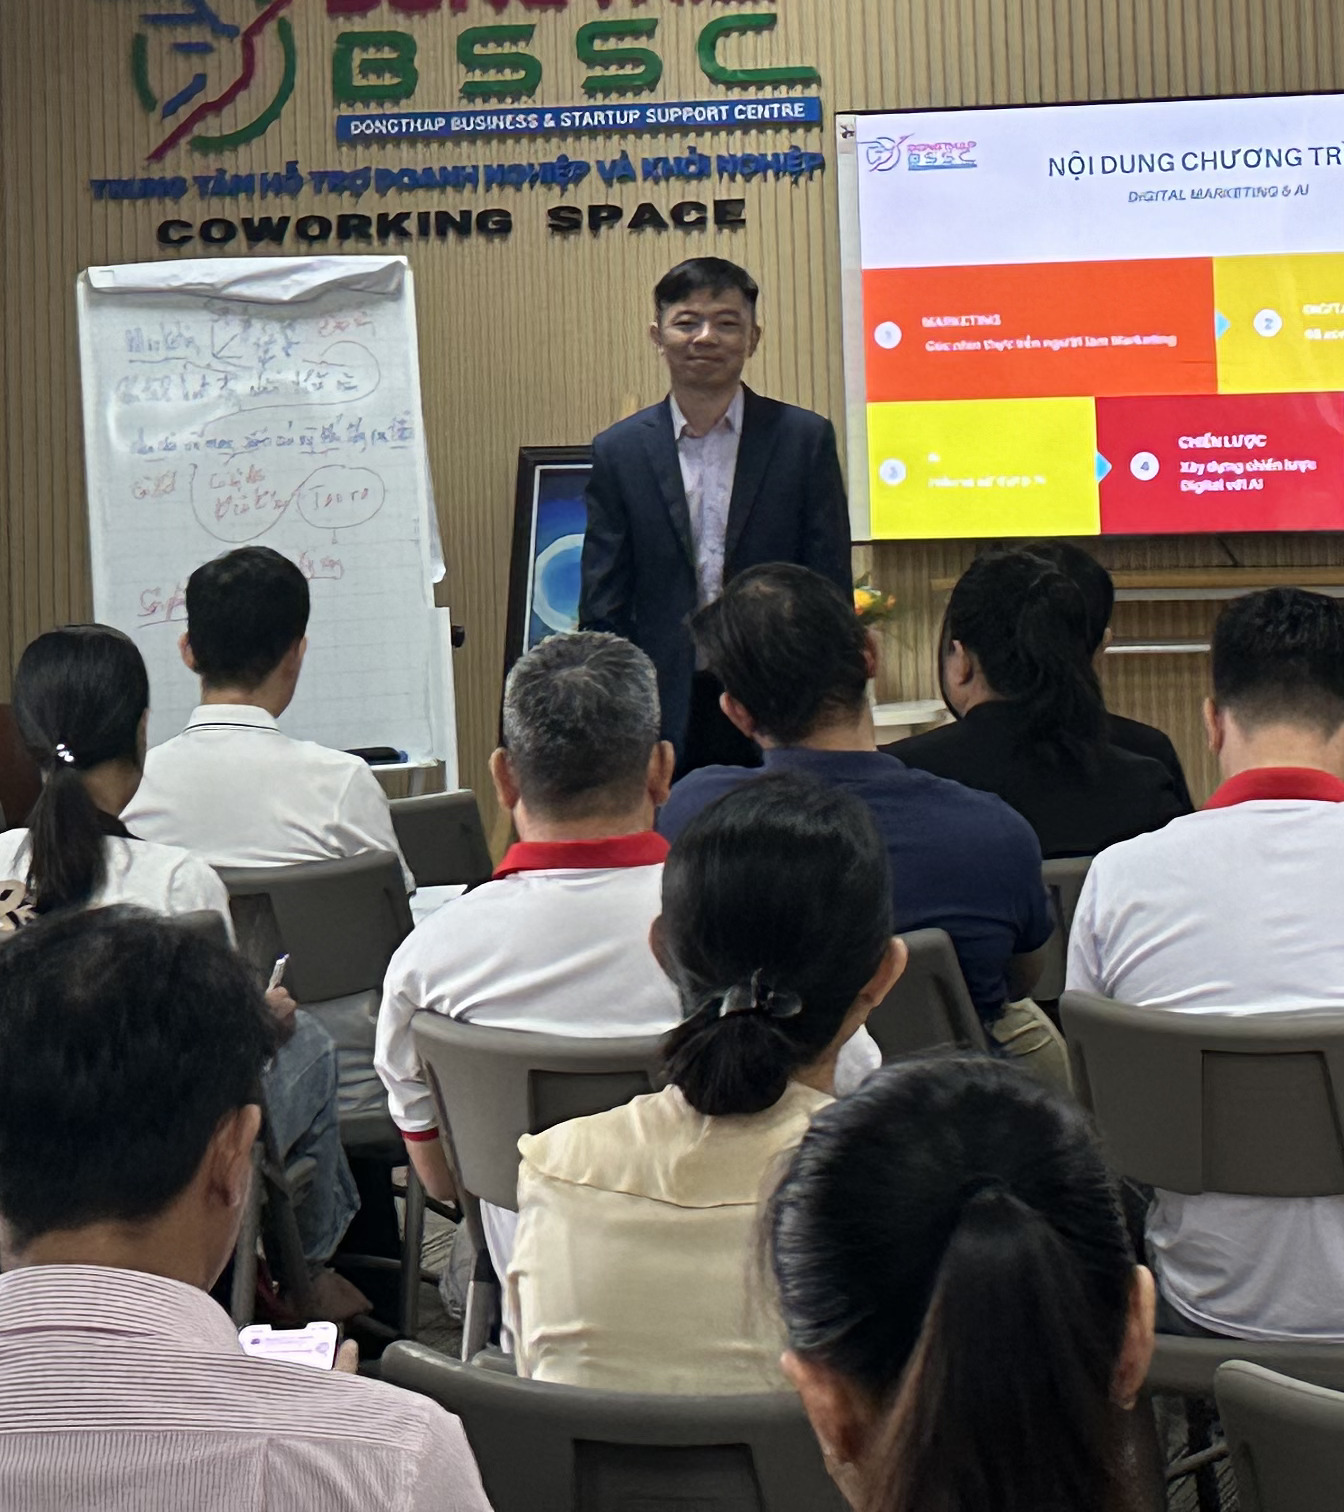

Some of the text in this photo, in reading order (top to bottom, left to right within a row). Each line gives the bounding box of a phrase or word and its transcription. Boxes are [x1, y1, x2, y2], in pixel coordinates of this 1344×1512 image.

[333, 13, 821, 102] BSSC
[350, 102, 806, 135] DONGTHAP BUSINESS & STARTUP SUPPORT CENTRE
[375, 166, 480, 196] DOANH
[596, 149, 637, 188] VÀ
[1048, 150, 1094, 181] NỘI
[1100, 152, 1175, 175] DUNG
[1181, 147, 1303, 172] CHƯƠNG
[1128, 190, 1186, 203] DIGITAL
[1190, 186, 1279, 200] MARKETING
[156, 198, 746, 245] COWORKING SPACE
[921, 314, 1001, 328] MARKETING
